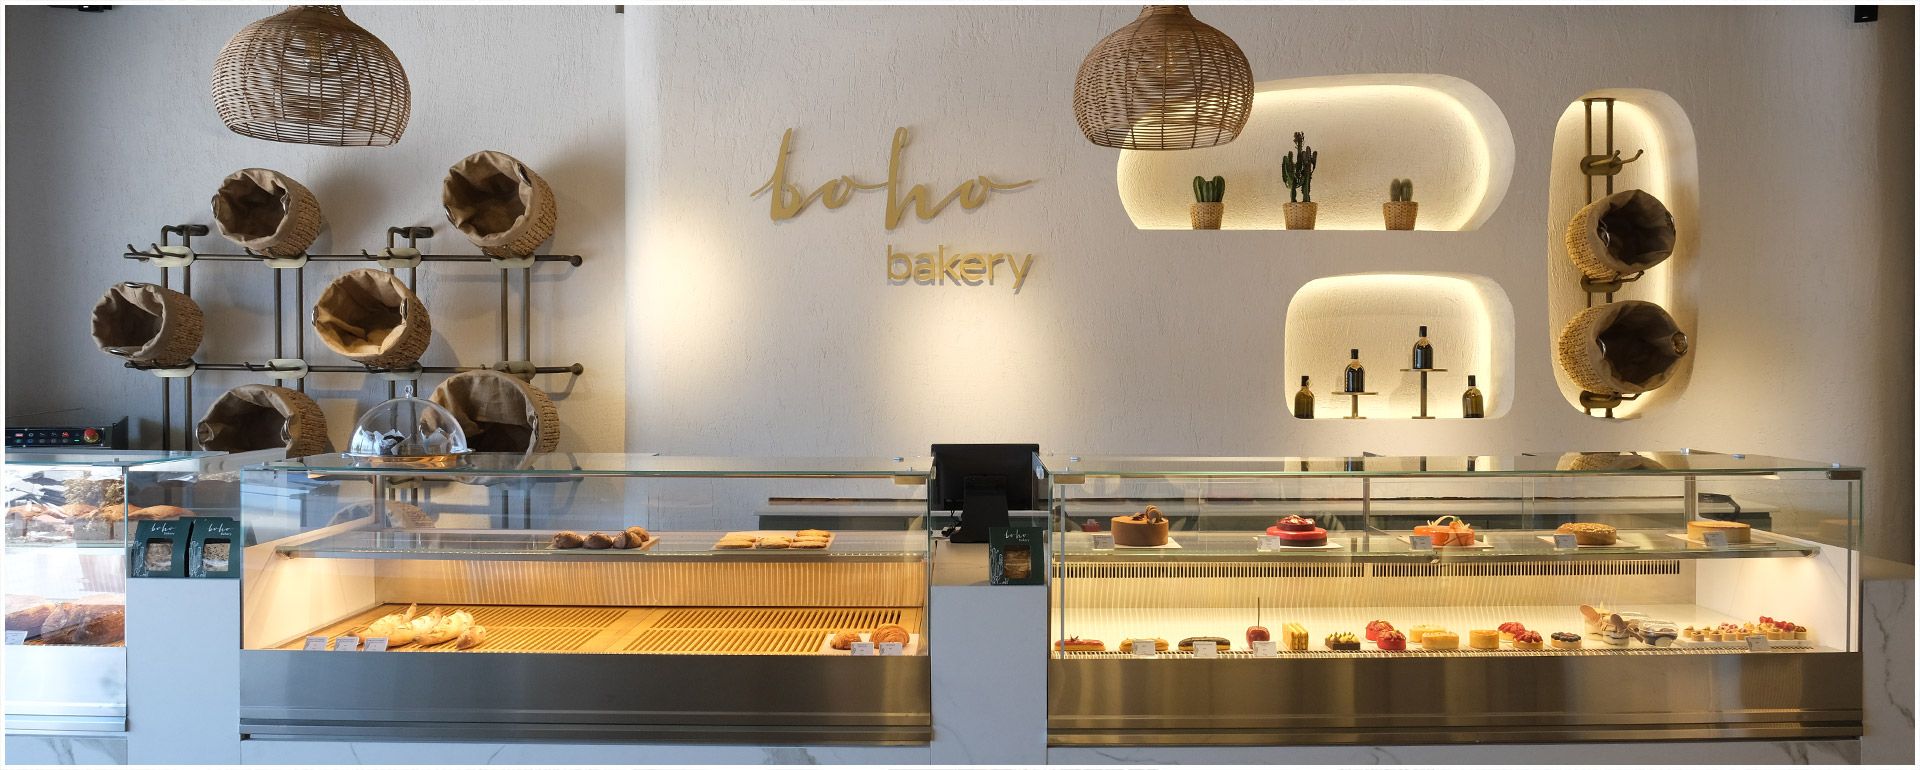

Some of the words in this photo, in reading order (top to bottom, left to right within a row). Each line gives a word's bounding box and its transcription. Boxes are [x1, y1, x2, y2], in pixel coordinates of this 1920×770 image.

[750, 127, 1032, 230] boho
[887, 244, 1033, 290] bakery
[150, 523, 176, 532] boho
[207, 523, 233, 532] boho
[1004, 529, 1029, 539] boho
